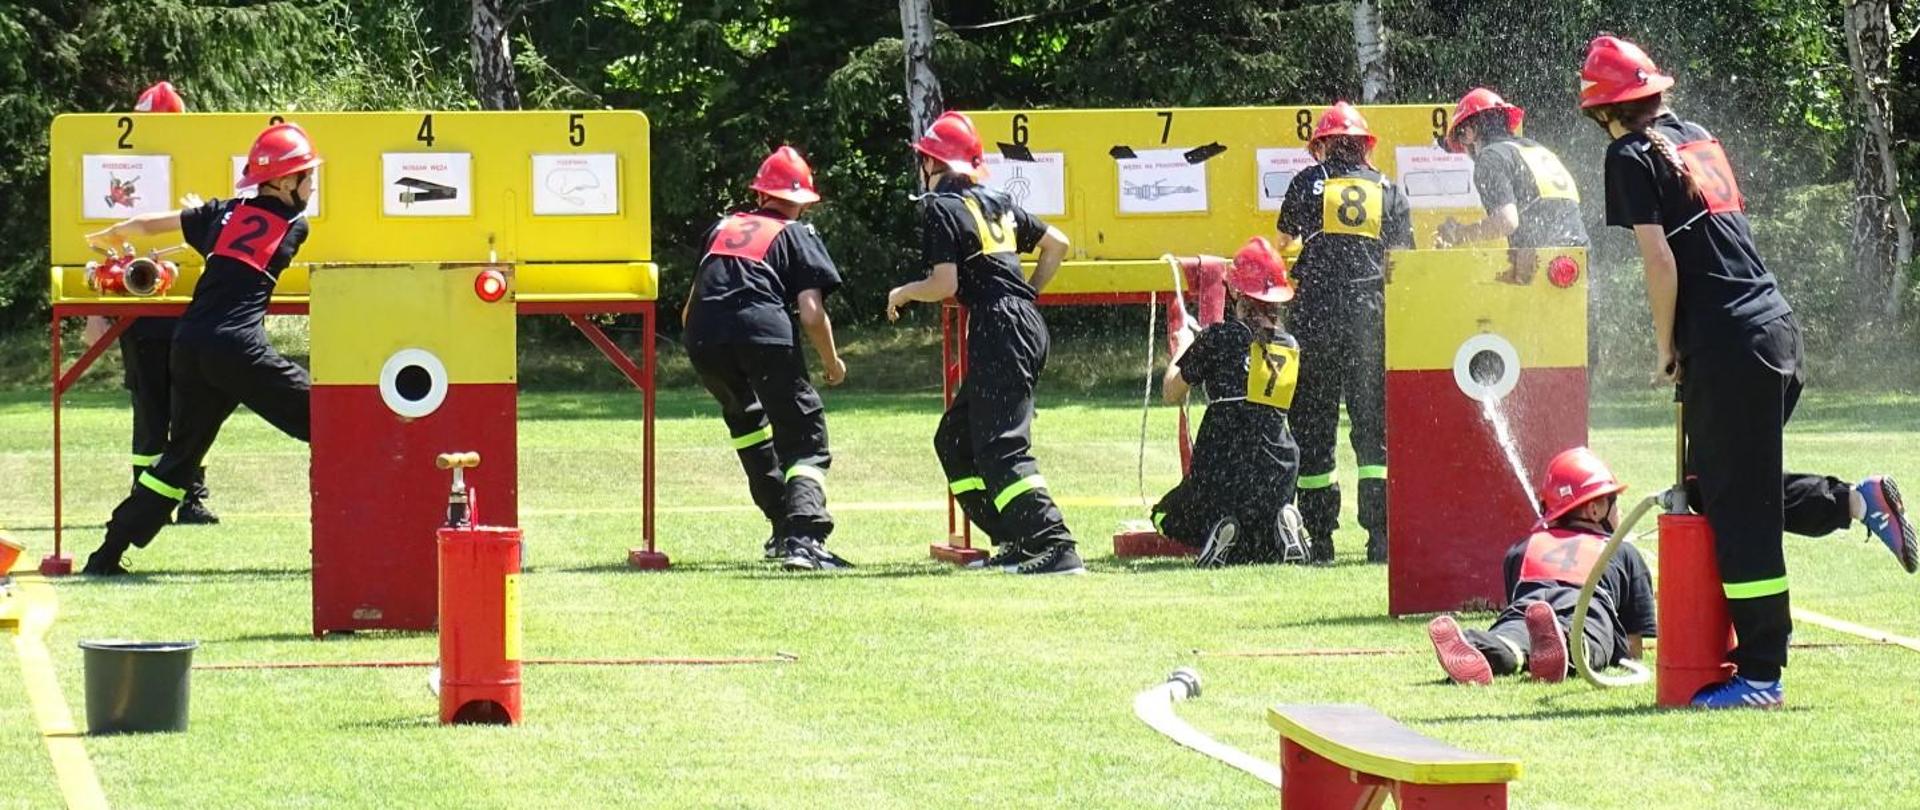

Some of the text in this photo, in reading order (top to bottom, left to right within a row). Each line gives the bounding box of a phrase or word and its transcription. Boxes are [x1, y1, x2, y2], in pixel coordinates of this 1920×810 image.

[118, 116, 134, 149] 2
[417, 114, 435, 147] 4
[569, 113, 586, 147] 5
[1012, 113, 1029, 146] 6
[1156, 112, 1173, 144] 7
[1296, 109, 1312, 141] 8
[1432, 107, 1448, 139] 9
[1695, 151, 1731, 202] 5
[1336, 185, 1368, 227] 8
[228, 214, 269, 256] 2
[725, 220, 762, 250] 3
[1262, 352, 1286, 397] 7
[1541, 539, 1578, 572] 4
